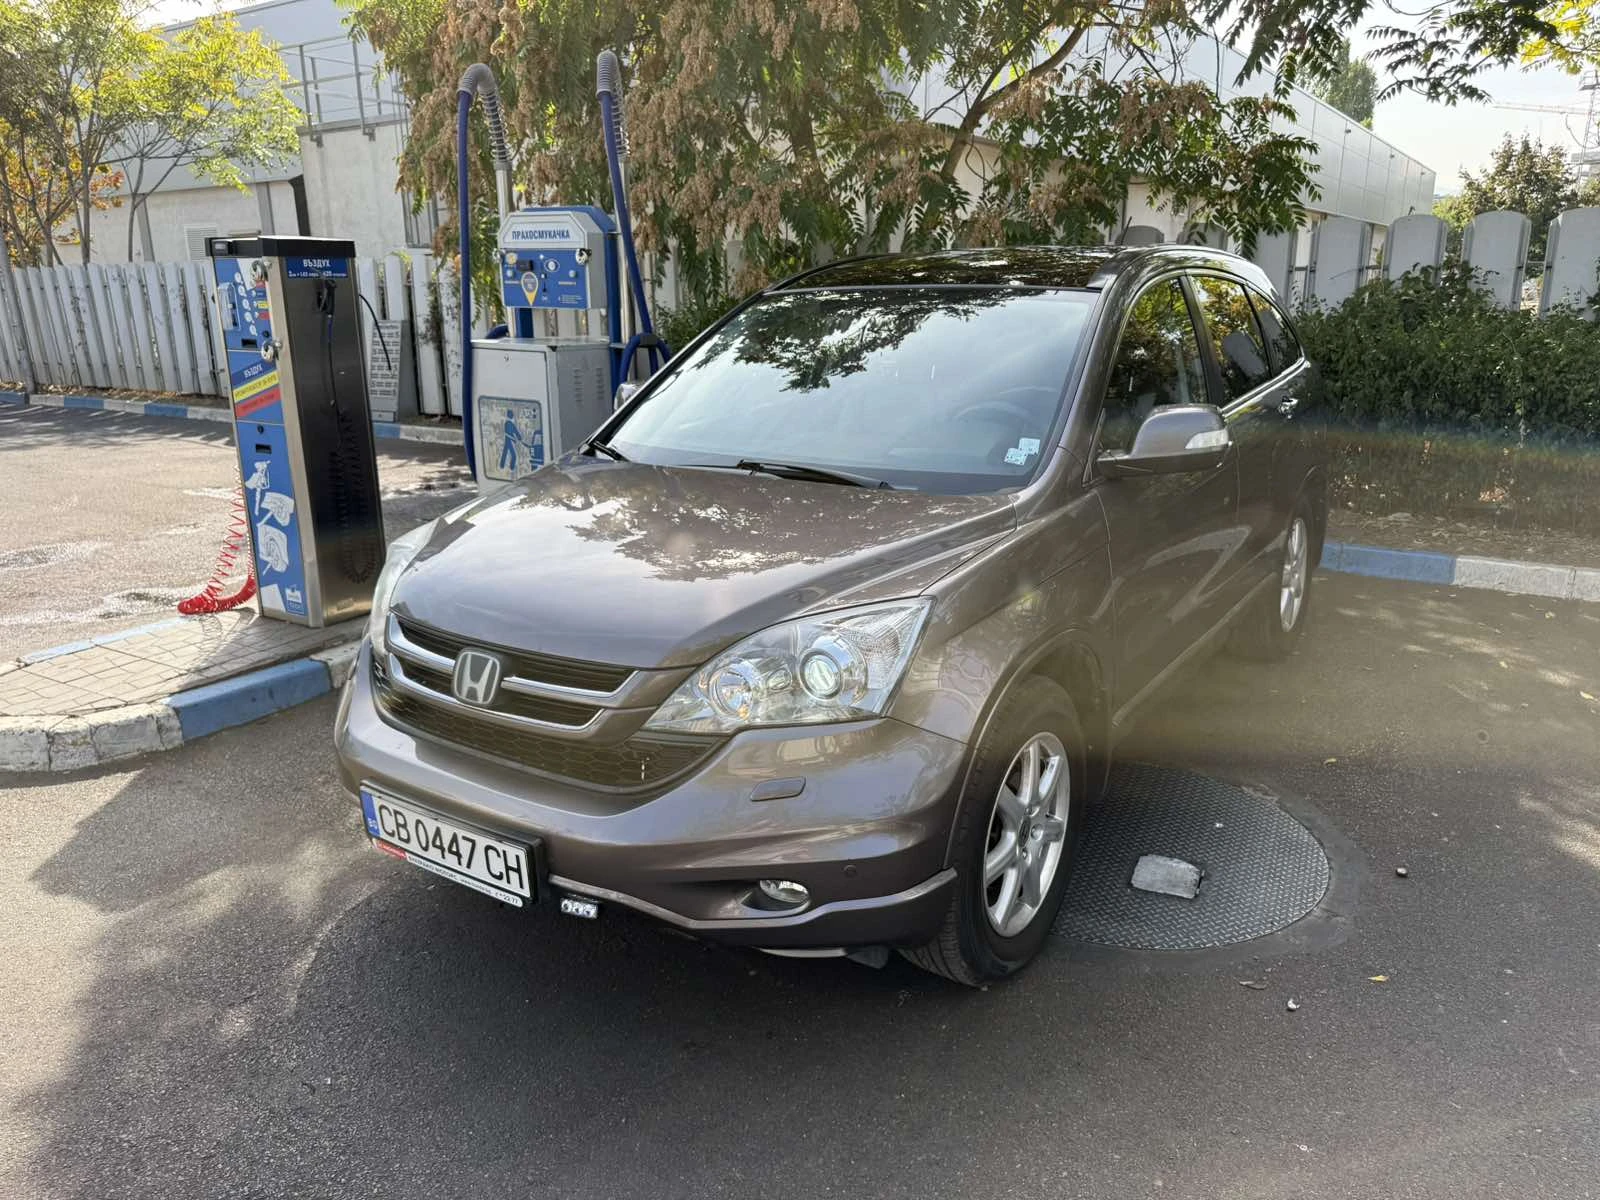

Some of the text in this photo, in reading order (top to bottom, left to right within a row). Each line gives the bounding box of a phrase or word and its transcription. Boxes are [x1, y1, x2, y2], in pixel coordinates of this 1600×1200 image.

[512, 229, 570, 240] ПРАХОСМУКАЧКА
[302, 258, 331, 268] ВЪЗДУХ
[243, 364, 263, 378] ВЪЗДУХ
[378, 804, 411, 844] CB
[415, 818, 477, 870] 0447
[484, 844, 524, 890] CH
